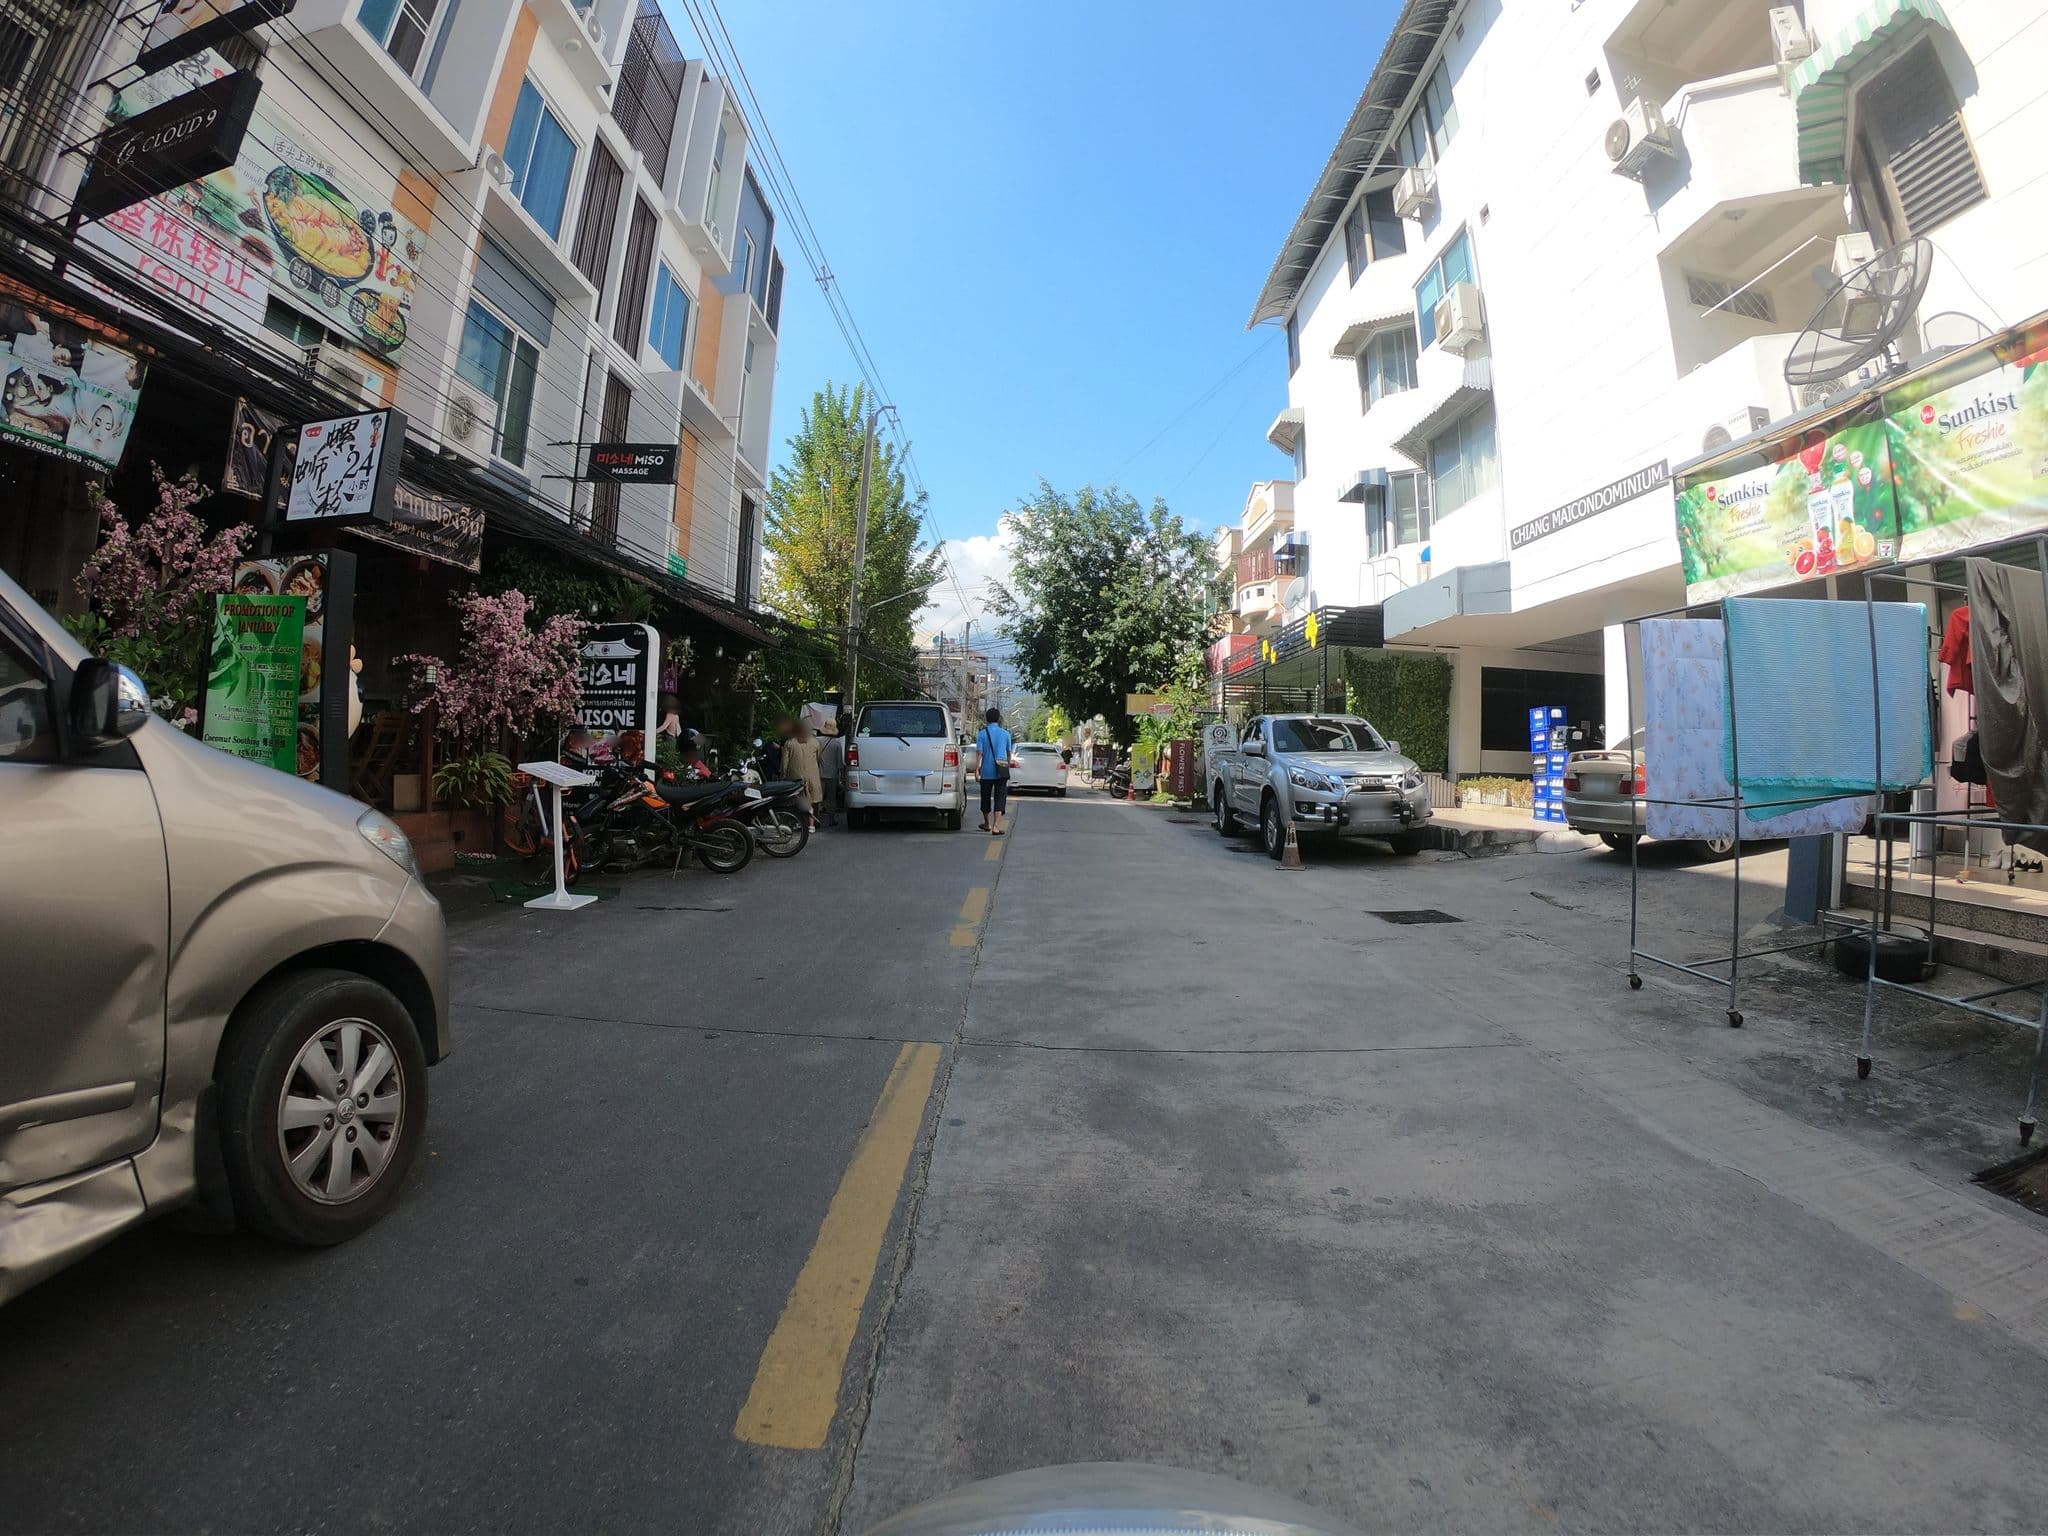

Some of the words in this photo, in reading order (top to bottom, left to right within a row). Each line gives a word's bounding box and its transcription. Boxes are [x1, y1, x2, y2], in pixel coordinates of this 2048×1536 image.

[142, 116, 202, 153] CLOUD
[205, 109, 218, 129] 9
[1938, 392, 2019, 436] Sunkist
[1956, 421, 2007, 451] Freshie
[344, 450, 374, 478] 24
[611, 467, 650, 476] MASSAGE
[1512, 515, 1550, 546] CHIANG
[1551, 463, 1664, 529] MAICONDOMINIUM
[1718, 480, 1771, 511] Sunkist
[223, 604, 279, 617] PROMOTION
[281, 605, 296, 618] OF
